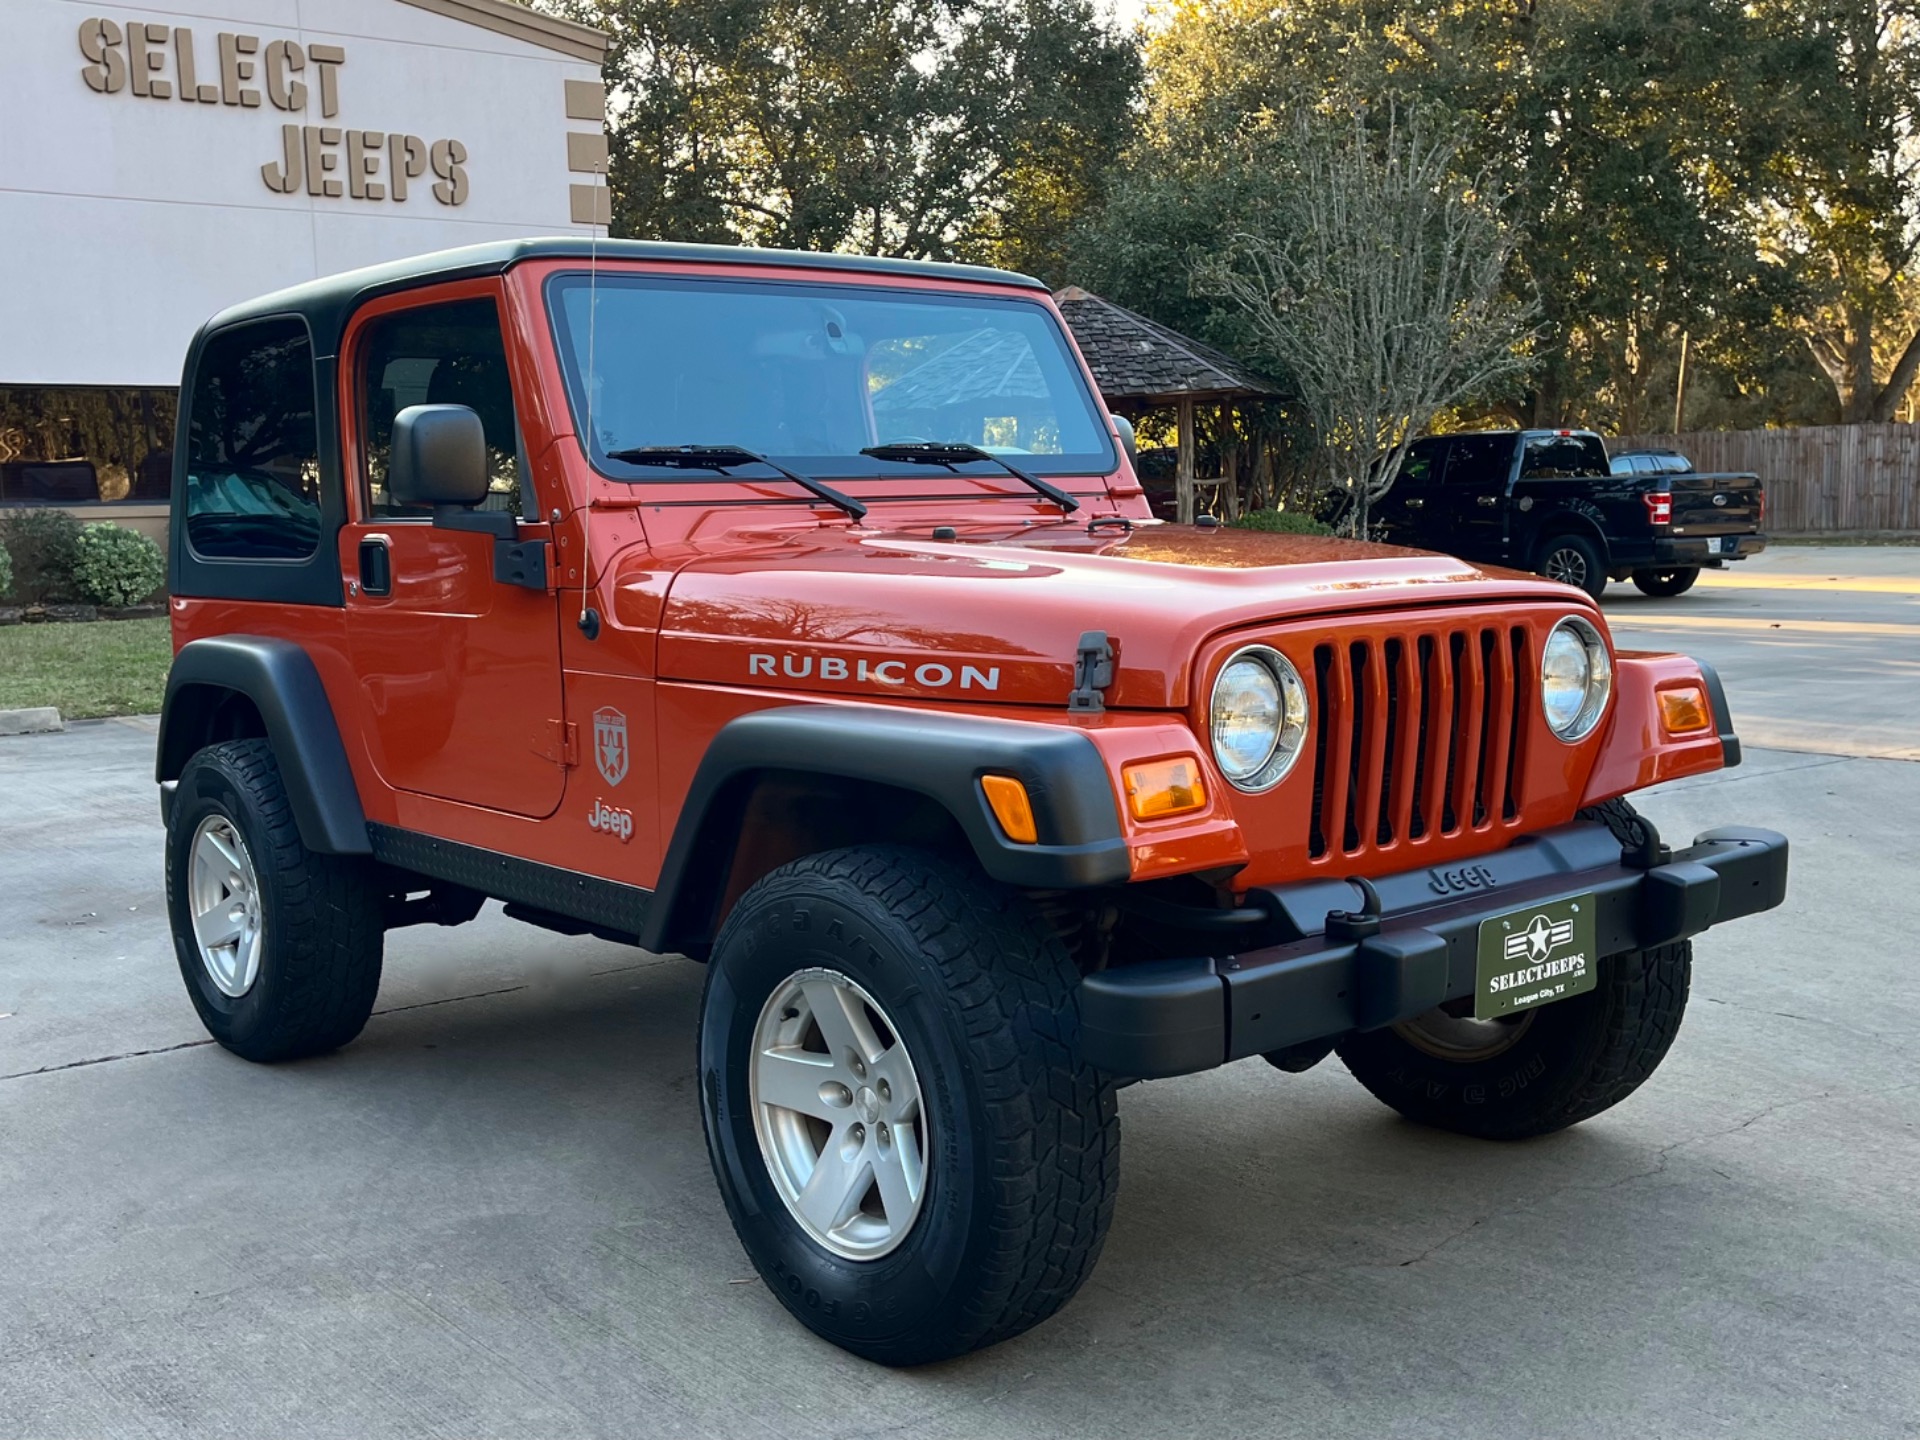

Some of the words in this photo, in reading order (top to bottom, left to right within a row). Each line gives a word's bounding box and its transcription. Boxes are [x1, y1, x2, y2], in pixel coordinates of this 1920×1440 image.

[79, 18, 345, 118] SELECT
[261, 123, 469, 206] JEEPS
[749, 653, 1000, 691] RUBICON
[588, 797, 634, 842] Jeep
[1428, 864, 1496, 895] Jeep
[1490, 952, 1585, 994] SELECTJEEPS
[1513, 993, 1539, 1006] League
[1555, 983, 1566, 993] TX
